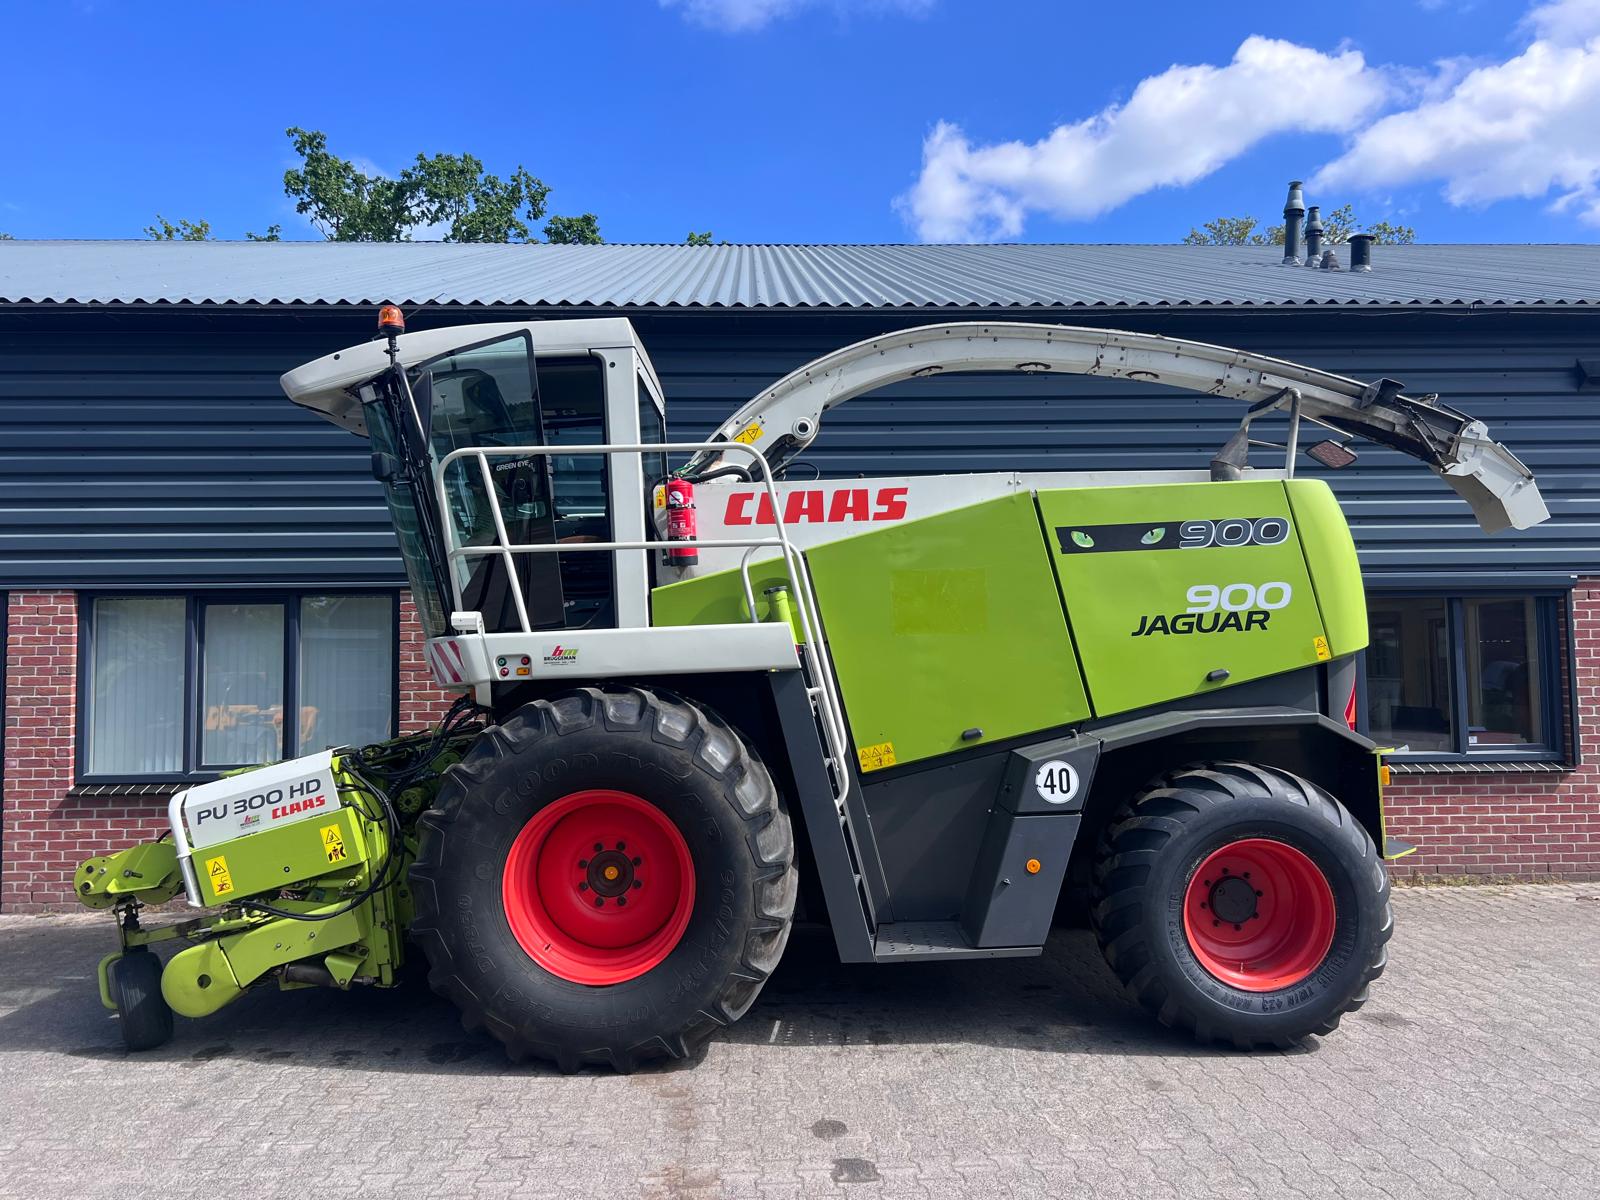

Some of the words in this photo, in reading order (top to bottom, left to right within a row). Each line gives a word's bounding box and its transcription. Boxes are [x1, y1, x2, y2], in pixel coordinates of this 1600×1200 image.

[724, 487, 908, 525] CLAAS
[1179, 517, 1290, 549] 900
[1186, 581, 1292, 614] 900
[1131, 610, 1271, 636] JAGUAR
[1043, 767, 1071, 795] 40
[197, 804, 228, 826] PU
[234, 790, 284, 816] 300
[289, 778, 321, 800] HD
[271, 795, 326, 820] CLAAS
